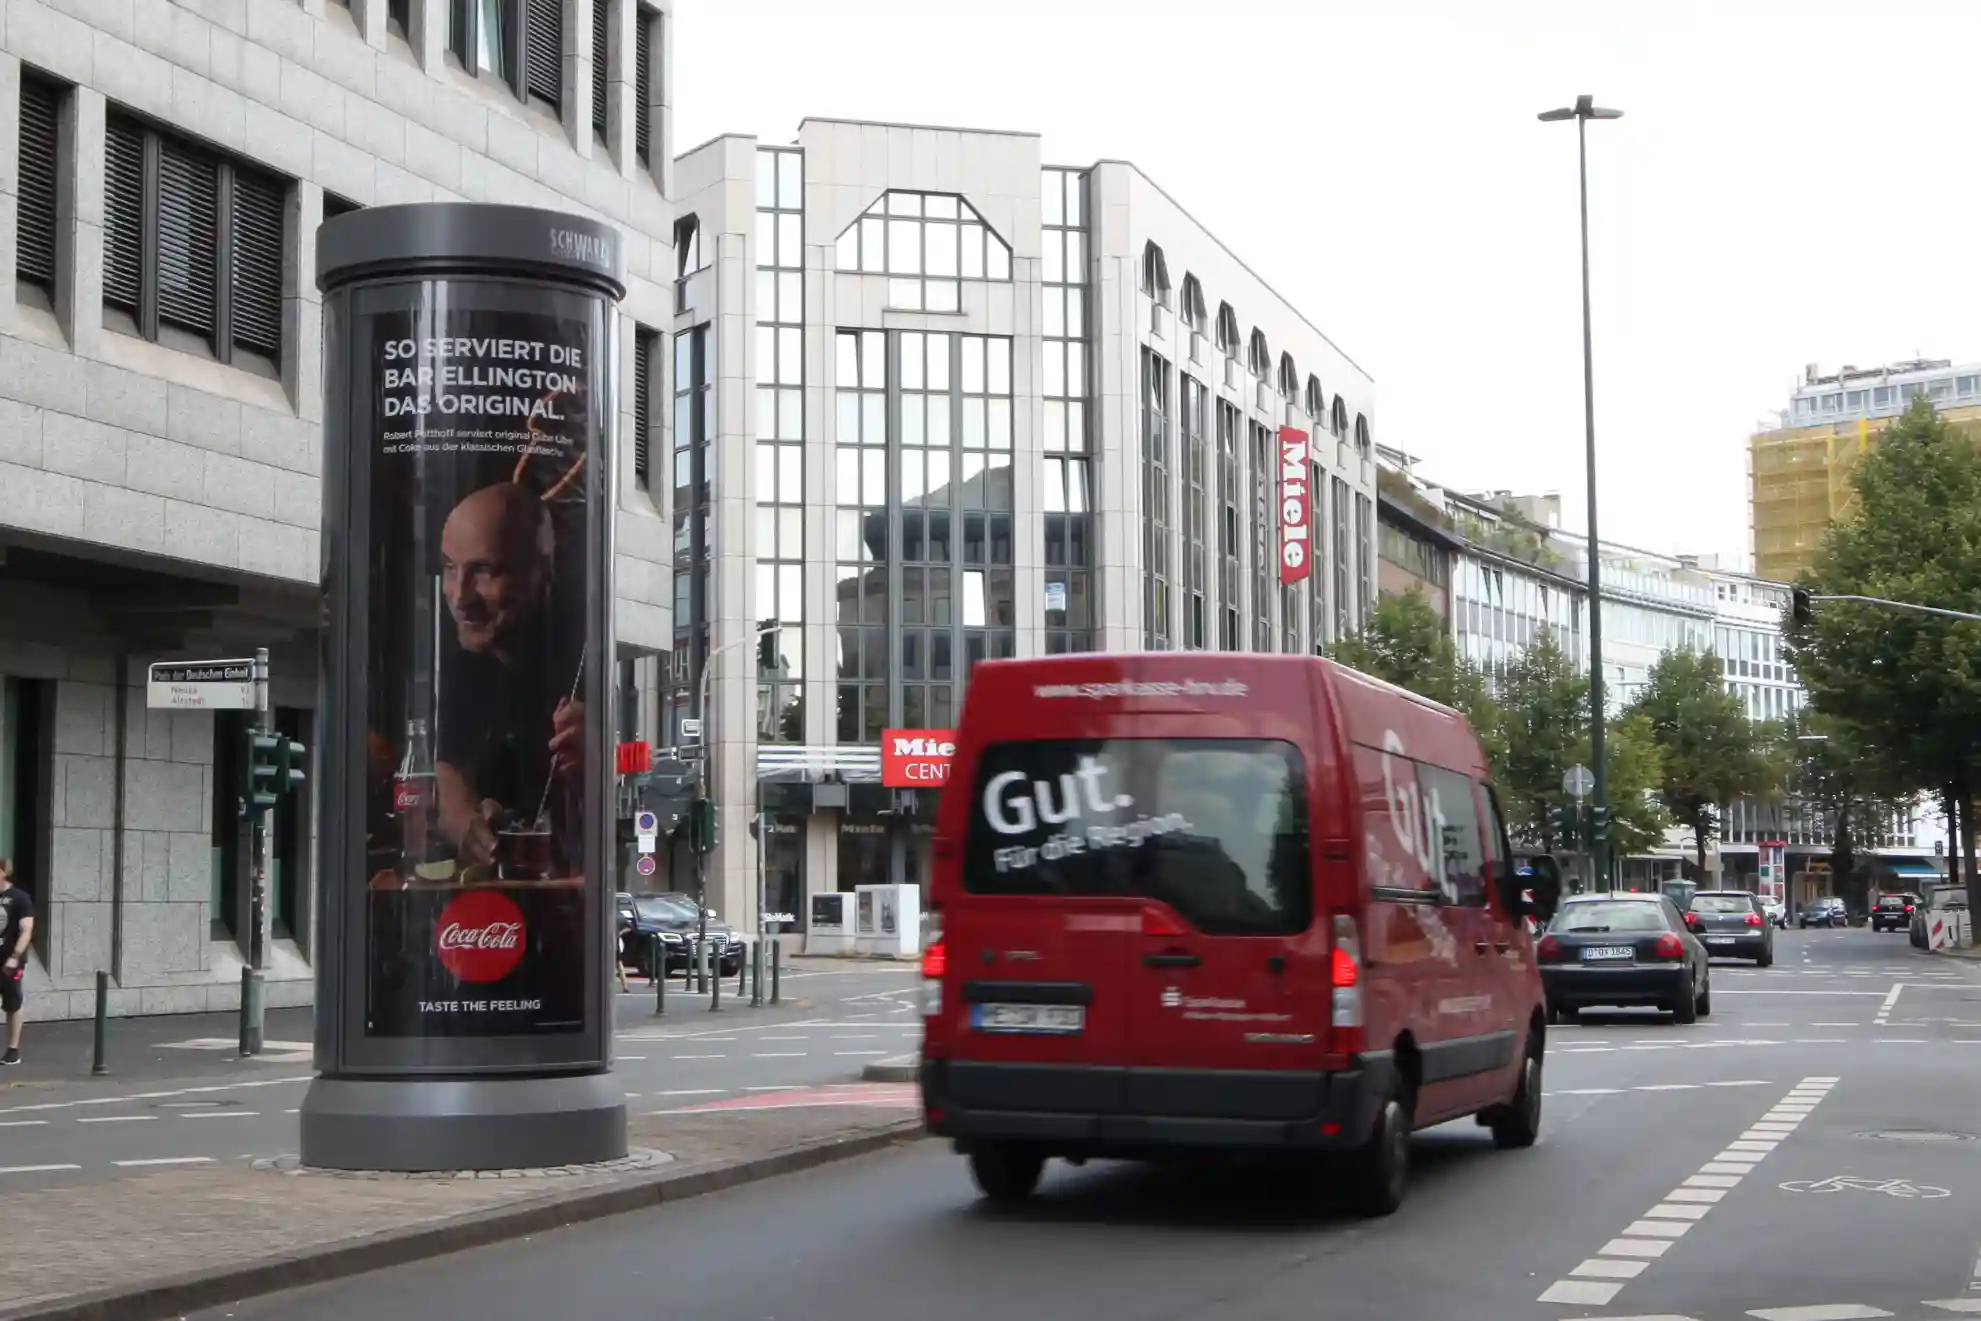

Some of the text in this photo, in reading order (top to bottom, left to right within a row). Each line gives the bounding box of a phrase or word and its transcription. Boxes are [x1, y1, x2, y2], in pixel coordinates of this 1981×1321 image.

[385, 338, 582, 369] SO SERVIERT DIE
[385, 366, 576, 394] BAR ELLINGTON
[385, 394, 565, 420] DAS ORIGINAL.
[495, 432, 530, 442] original
[1282, 440, 1308, 568] Miele
[983, 753, 1135, 834] Gut.
[419, 1000, 541, 1012] TASTE THE FEELING
